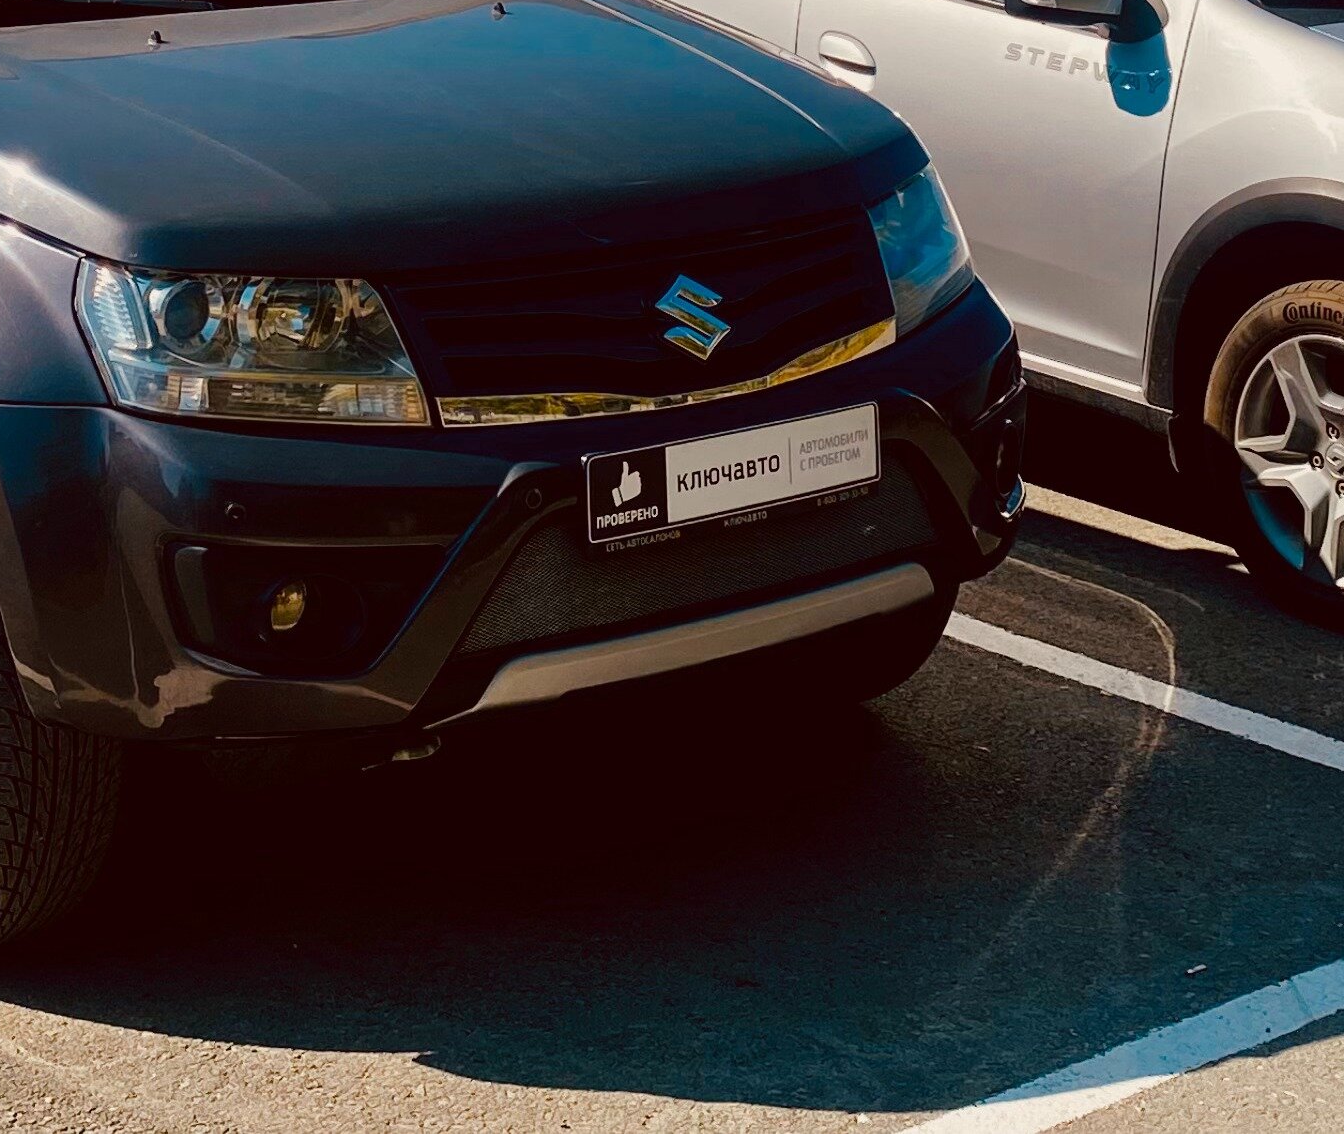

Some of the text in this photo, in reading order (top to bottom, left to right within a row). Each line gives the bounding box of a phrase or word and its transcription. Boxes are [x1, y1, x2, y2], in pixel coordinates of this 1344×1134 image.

[1004, 42, 1166, 94] STEPWAY
[799, 428, 869, 455] АВТОМОБИЛИ
[808, 446, 861, 470] ПРОБЕГОМ
[596, 506, 659, 530] ПРОВЕРЕНО
